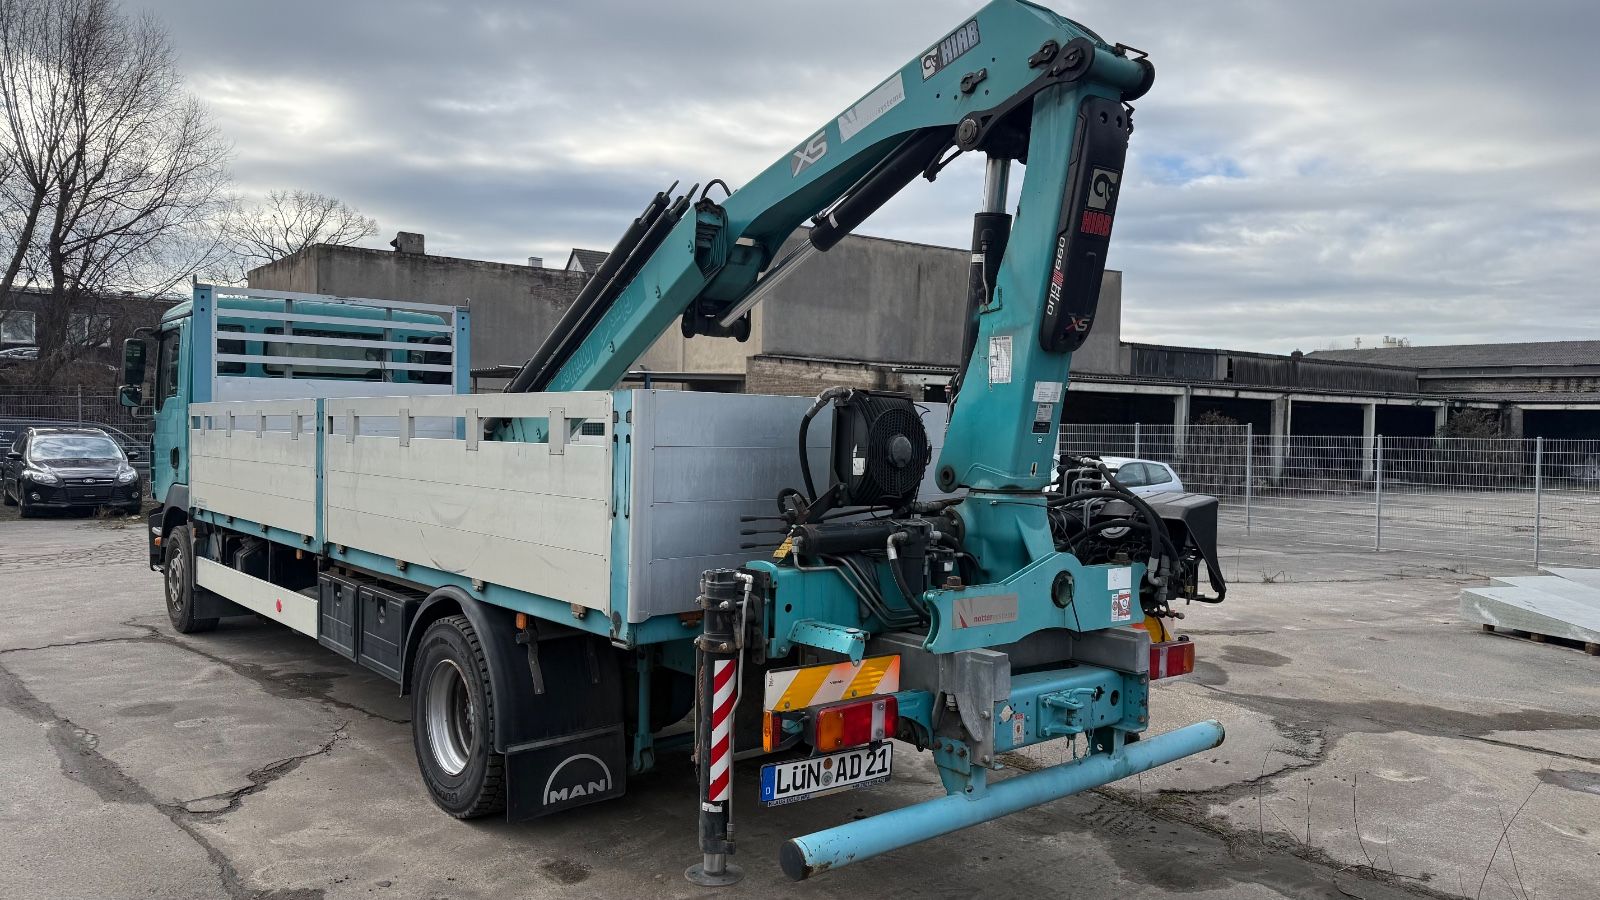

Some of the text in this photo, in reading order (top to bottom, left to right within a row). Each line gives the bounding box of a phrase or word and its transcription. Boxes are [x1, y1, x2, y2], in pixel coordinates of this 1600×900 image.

[940, 20, 979, 66] HIAB
[793, 130, 828, 178] XS
[1081, 210, 1112, 237] HIAB
[1065, 316, 1091, 332] XS
[776, 748, 888, 795] LÜN AD 21
[549, 779, 606, 804] MAN
[765, 786, 771, 795] D
